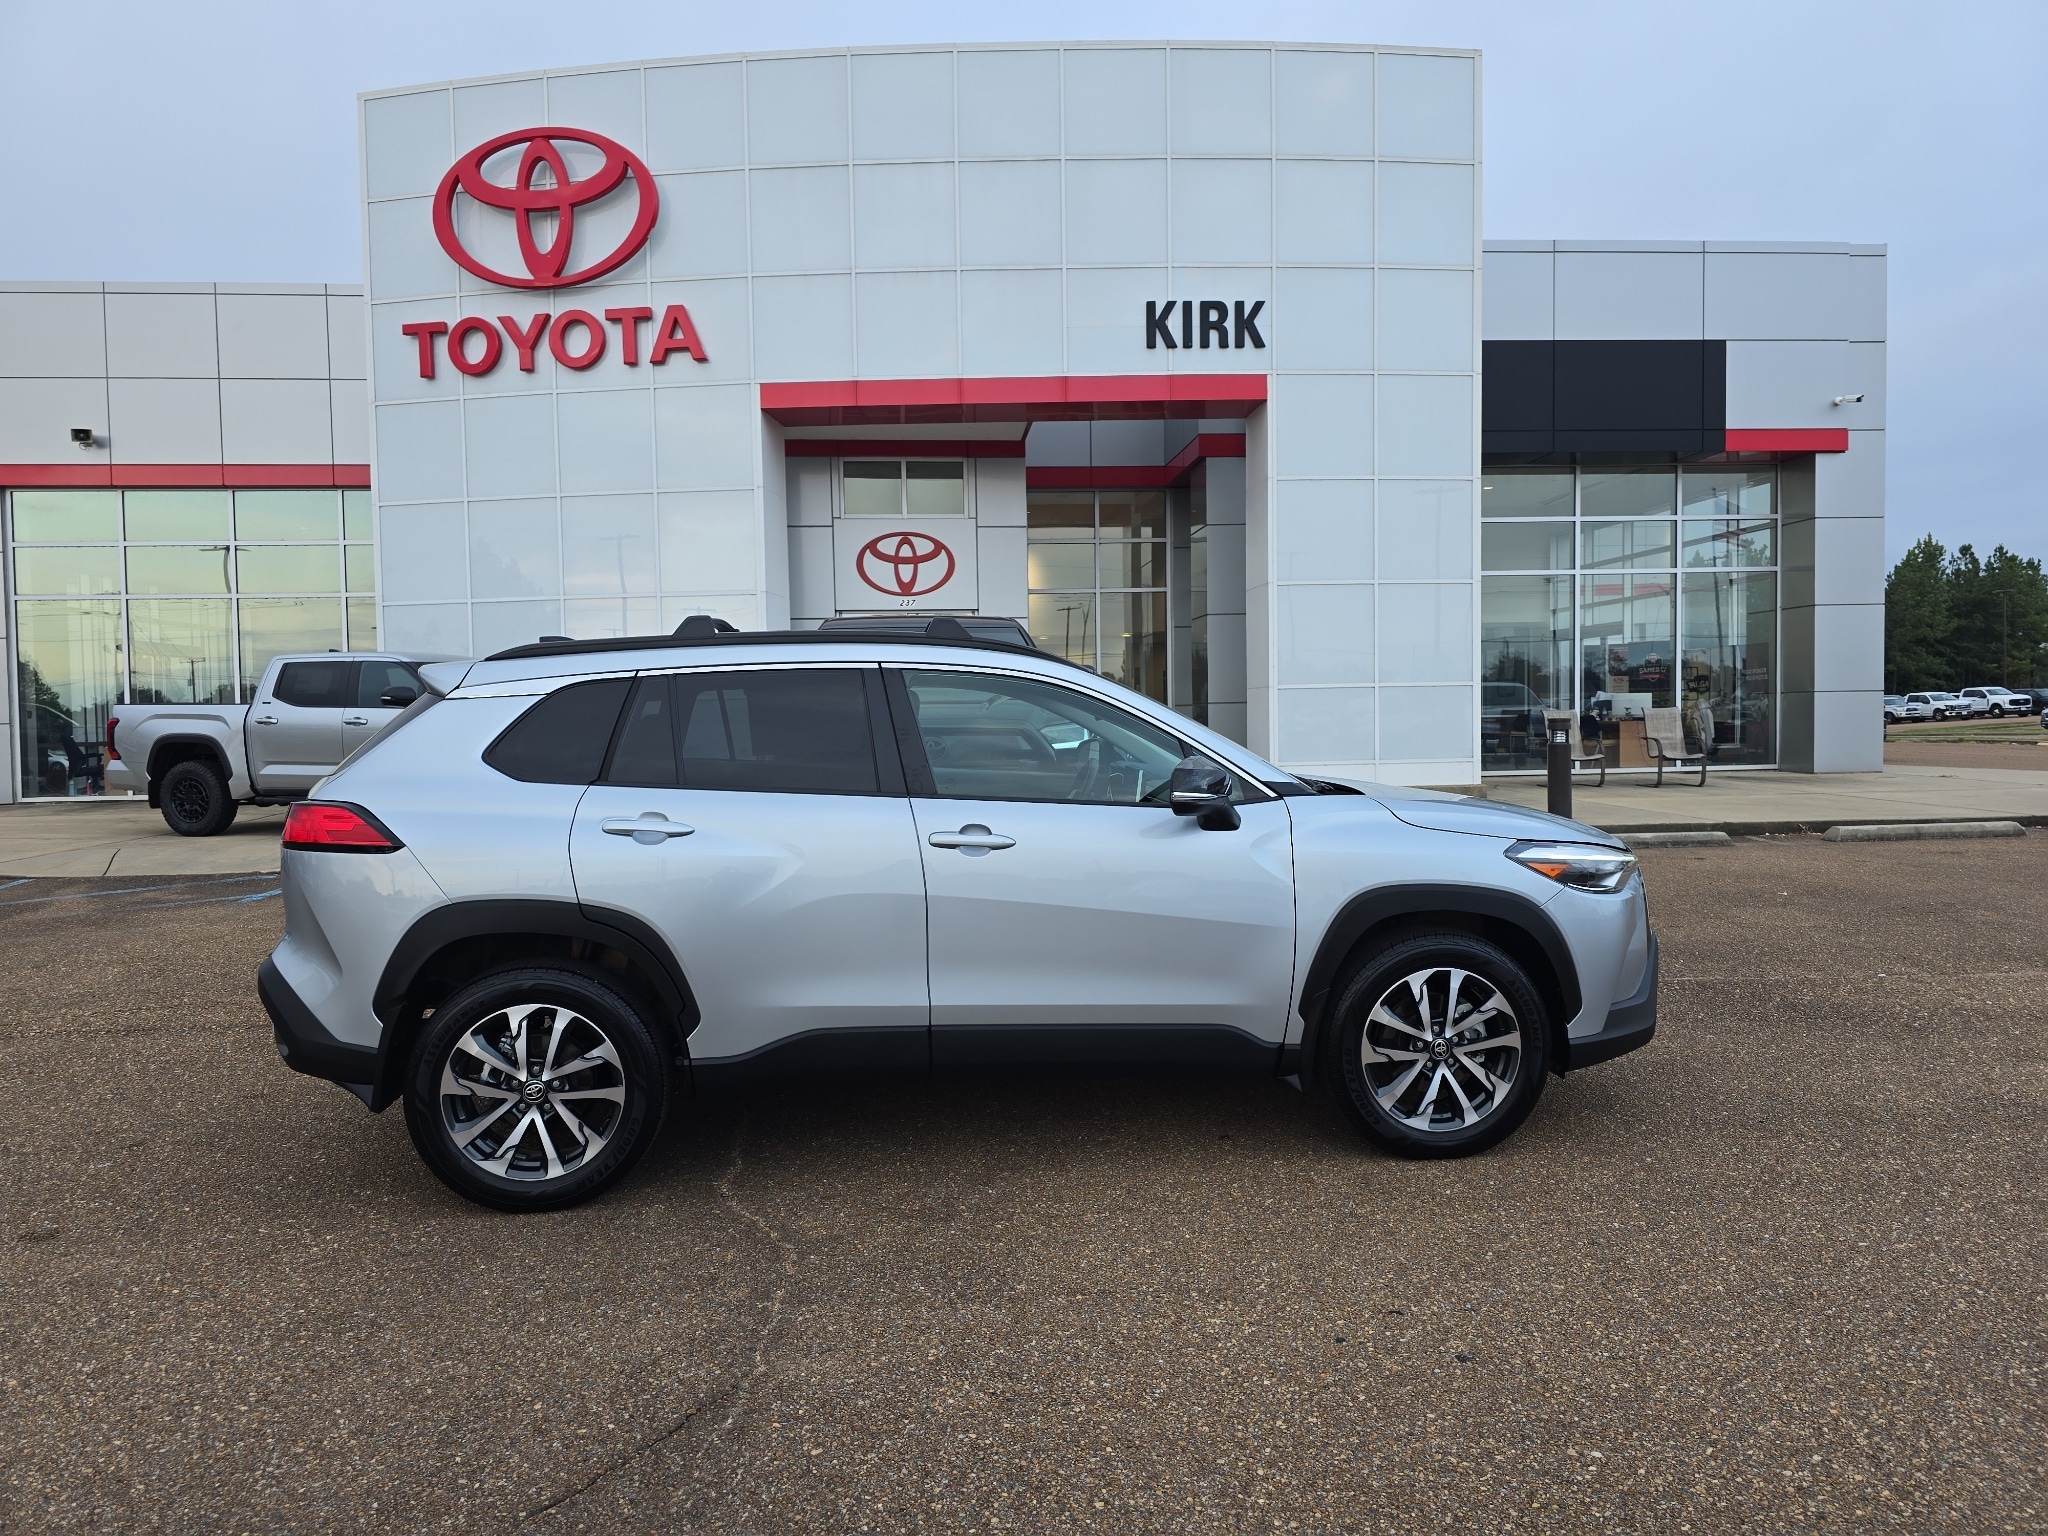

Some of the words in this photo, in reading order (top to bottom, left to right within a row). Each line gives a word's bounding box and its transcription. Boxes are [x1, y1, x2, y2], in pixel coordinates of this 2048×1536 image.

[402, 304, 708, 379] TOYOTA
[1146, 301, 1266, 348] KIRK
[1505, 979, 1542, 1054] ASSURANCE
